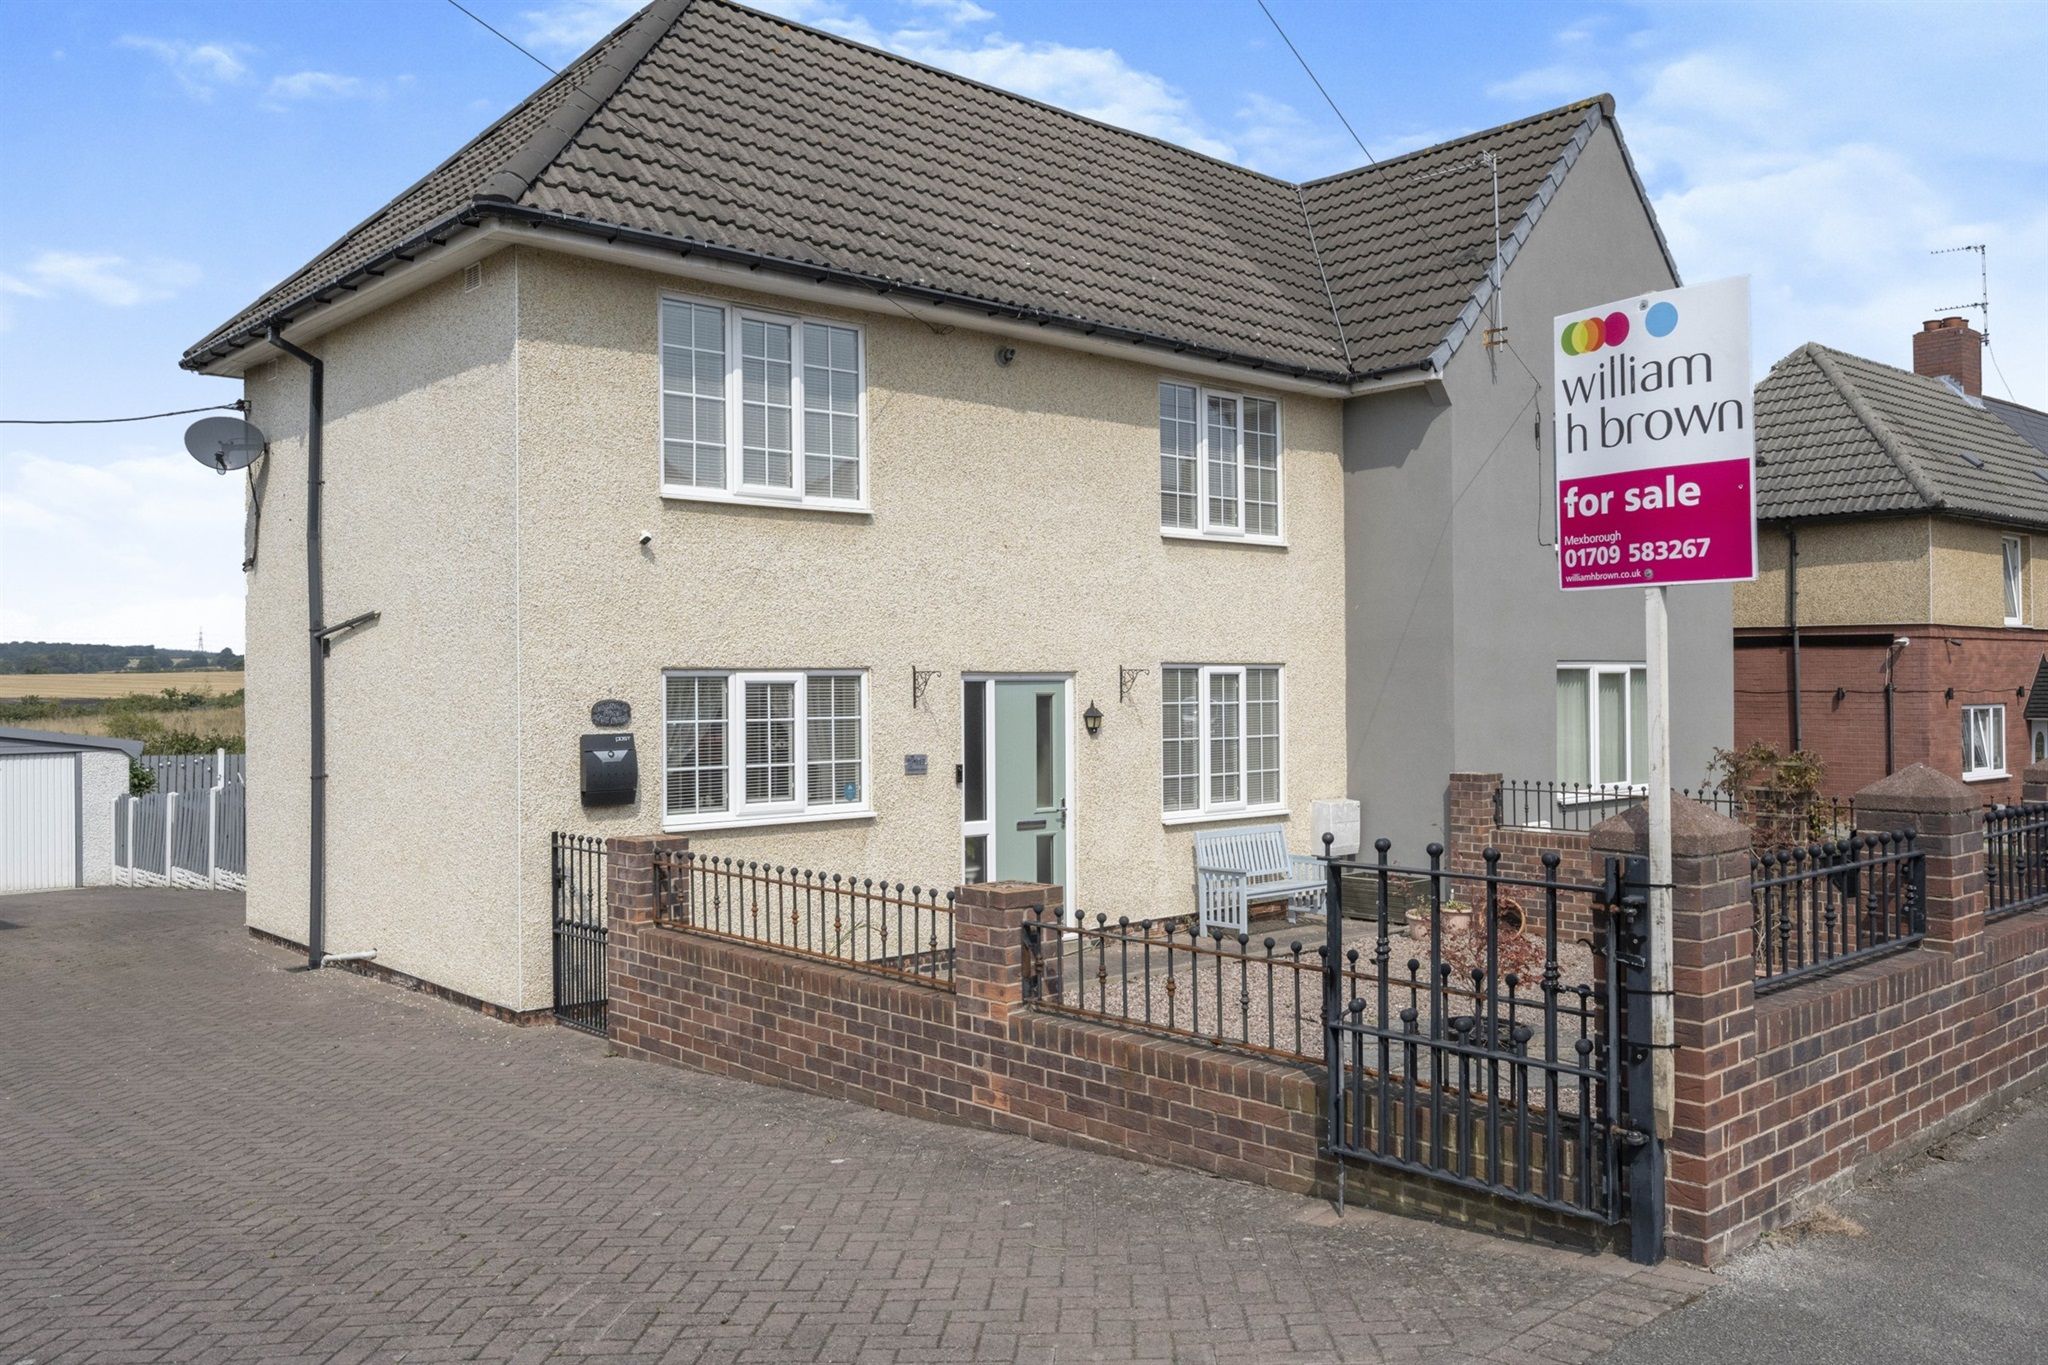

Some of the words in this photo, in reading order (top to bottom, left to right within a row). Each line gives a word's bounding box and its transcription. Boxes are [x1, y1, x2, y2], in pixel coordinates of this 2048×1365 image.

[1562, 353, 1712, 406] william
[1567, 413, 1588, 454] h
[1600, 399, 1743, 448] brown
[1564, 486, 1614, 518] for
[1624, 474, 1701, 512] sale
[1564, 530, 1622, 546] Mexborough
[1565, 545, 1620, 568] 01709
[1628, 537, 1711, 562] 583267
[1565, 569, 1642, 583] williamhbrown.co.uk
